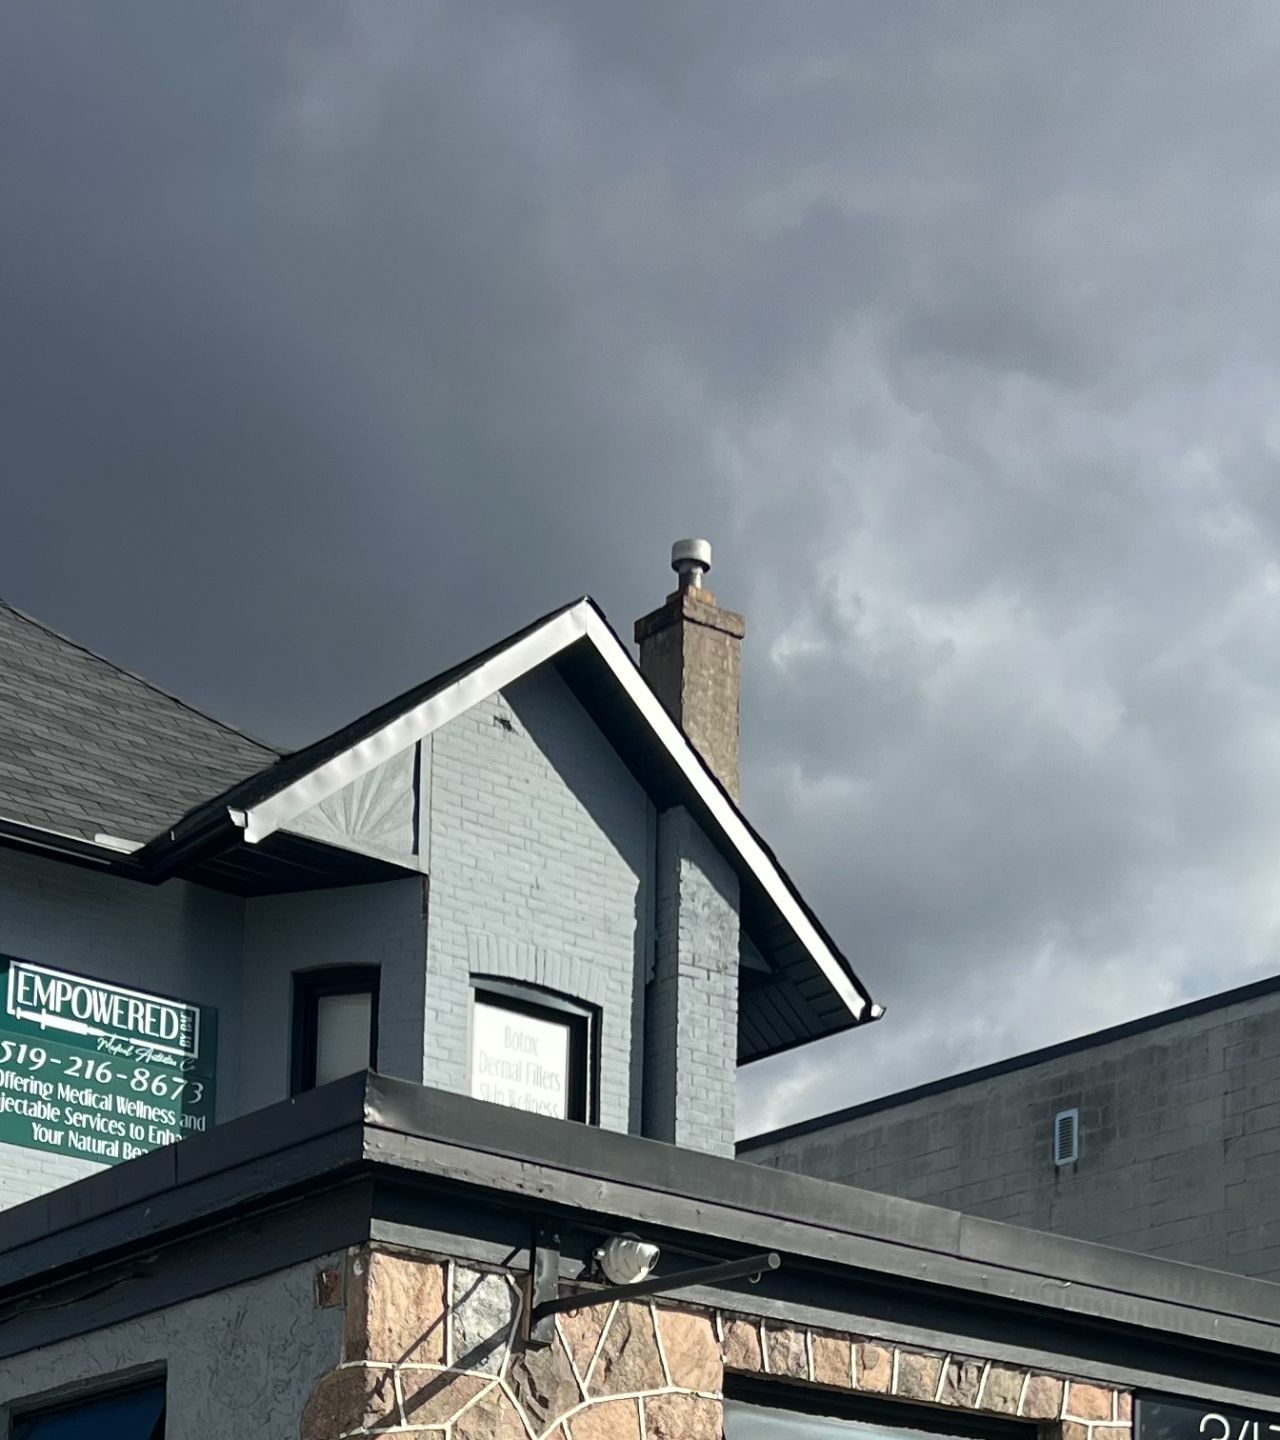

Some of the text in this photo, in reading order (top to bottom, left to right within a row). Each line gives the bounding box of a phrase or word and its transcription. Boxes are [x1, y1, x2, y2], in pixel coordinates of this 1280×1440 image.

[16, 970, 180, 1041] EMPOWERED
[479, 1050, 522, 1082] Dermal
[57, 1082, 113, 1112] Medical
[116, 1095, 177, 1127] Wellness
[179, 1113, 207, 1133] and
[64, 1106, 126, 1137] Services
[129, 1124, 145, 1141] to
[148, 1125, 186, 1146] Enha
[32, 1121, 65, 1146] Your
[67, 1134, 119, 1159] Natural
